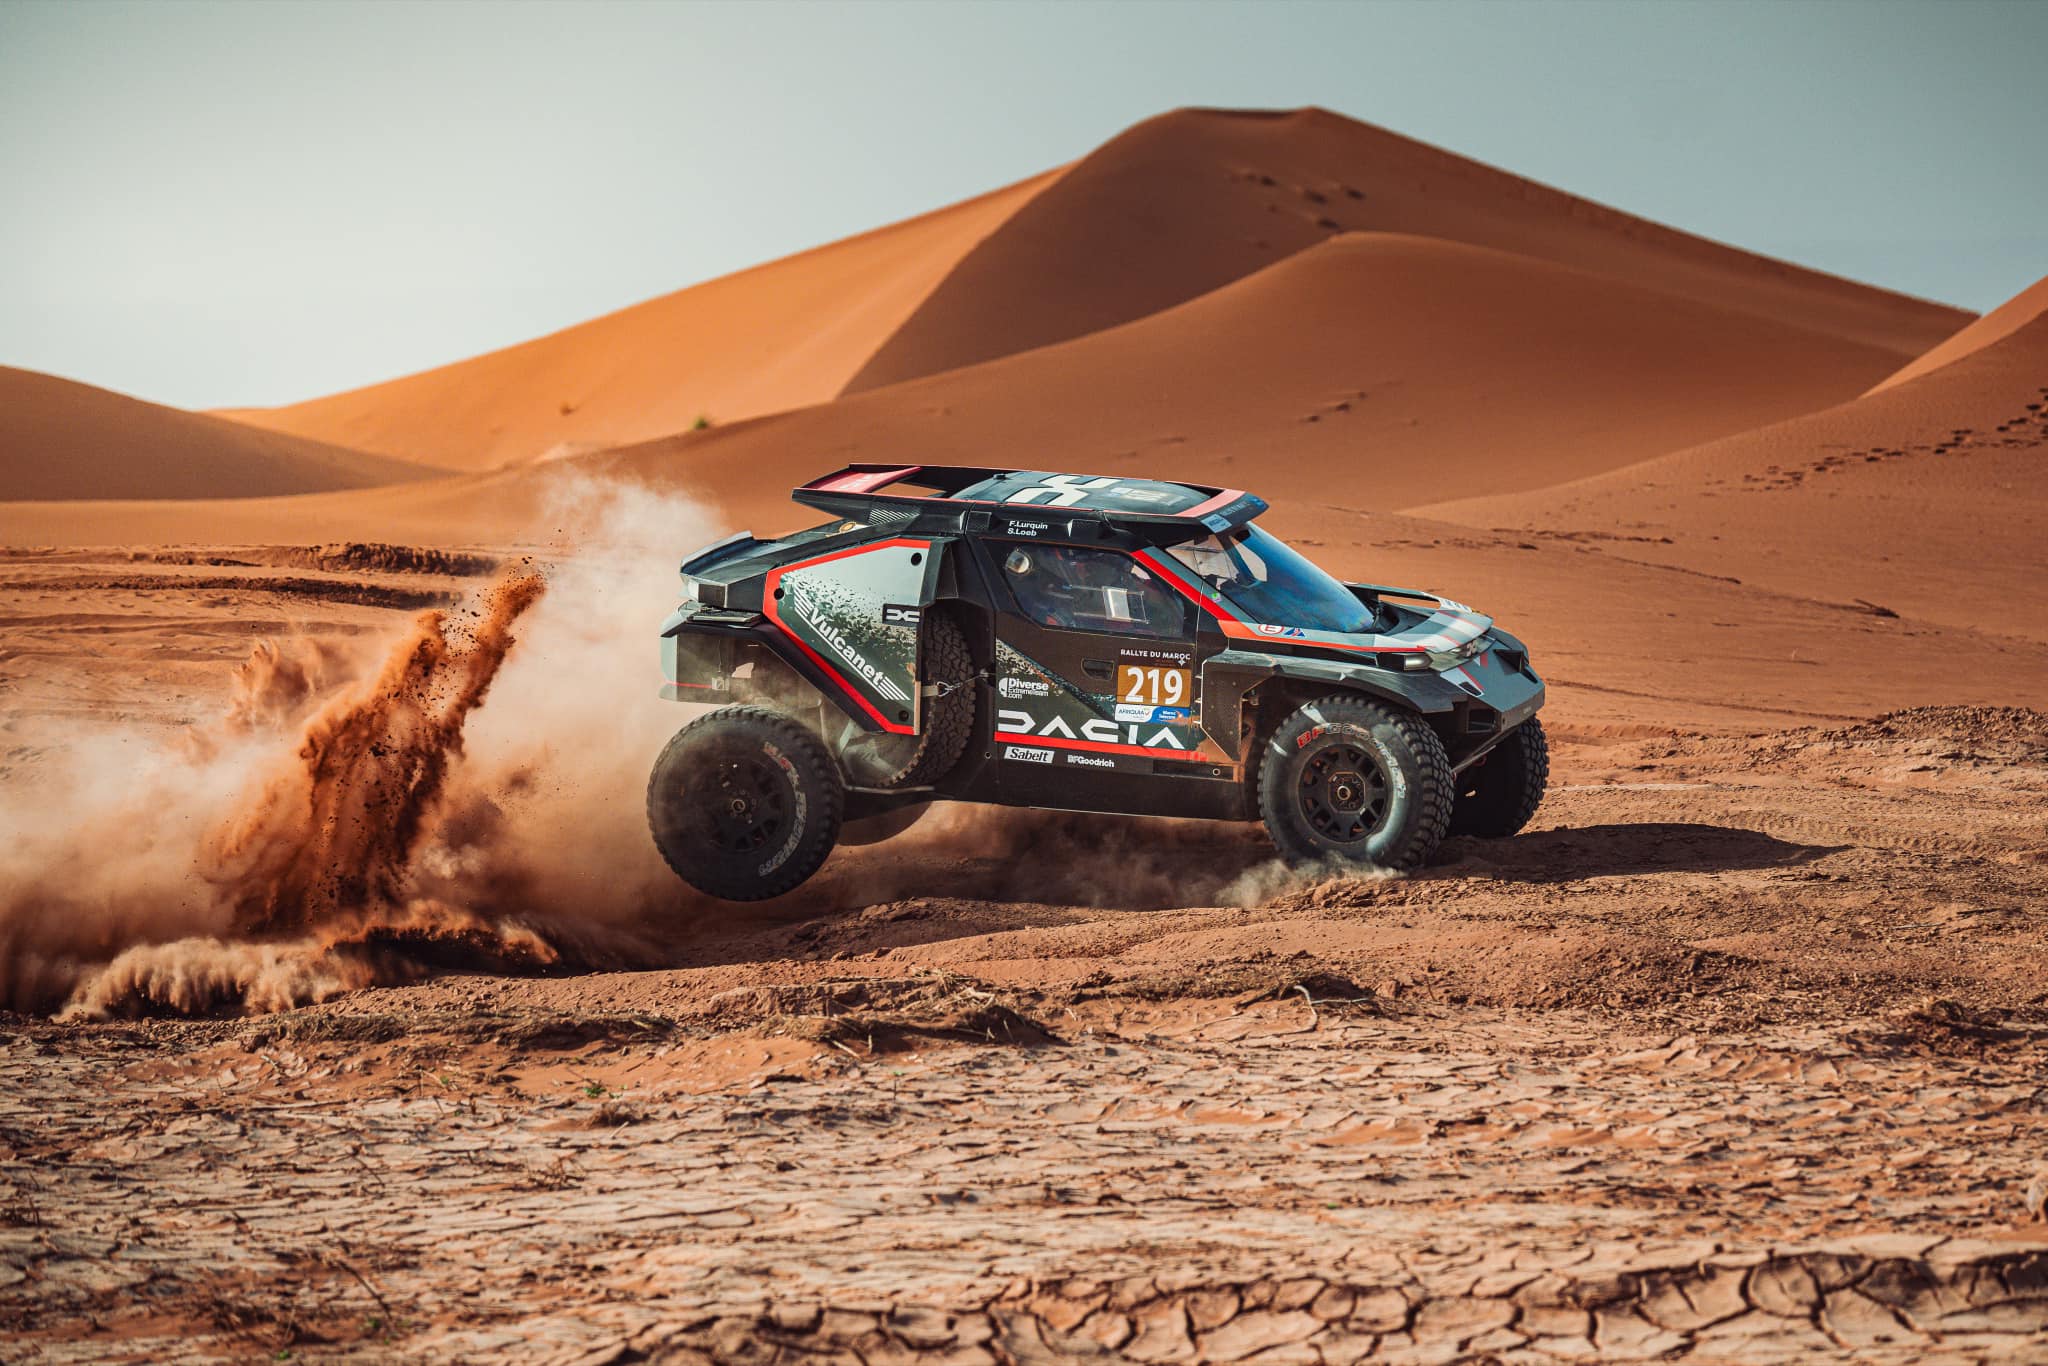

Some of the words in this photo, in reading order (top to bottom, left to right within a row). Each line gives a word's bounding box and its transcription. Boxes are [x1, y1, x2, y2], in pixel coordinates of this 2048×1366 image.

[1007, 527, 1037, 536] S.Loeb
[1009, 520, 1048, 530] F.Lurquin
[810, 607, 884, 686] Vulcanet
[1120, 648, 1148, 657] RALLYE
[1150, 650, 1161, 658] DU
[1162, 652, 1191, 660] MAROC
[1008, 677, 1049, 691] Diverse
[1125, 666, 1183, 705] 219
[997, 709, 1185, 750] DACIA
[1009, 747, 1049, 762] Sabelt
[1067, 754, 1115, 768] BFGoodrich
